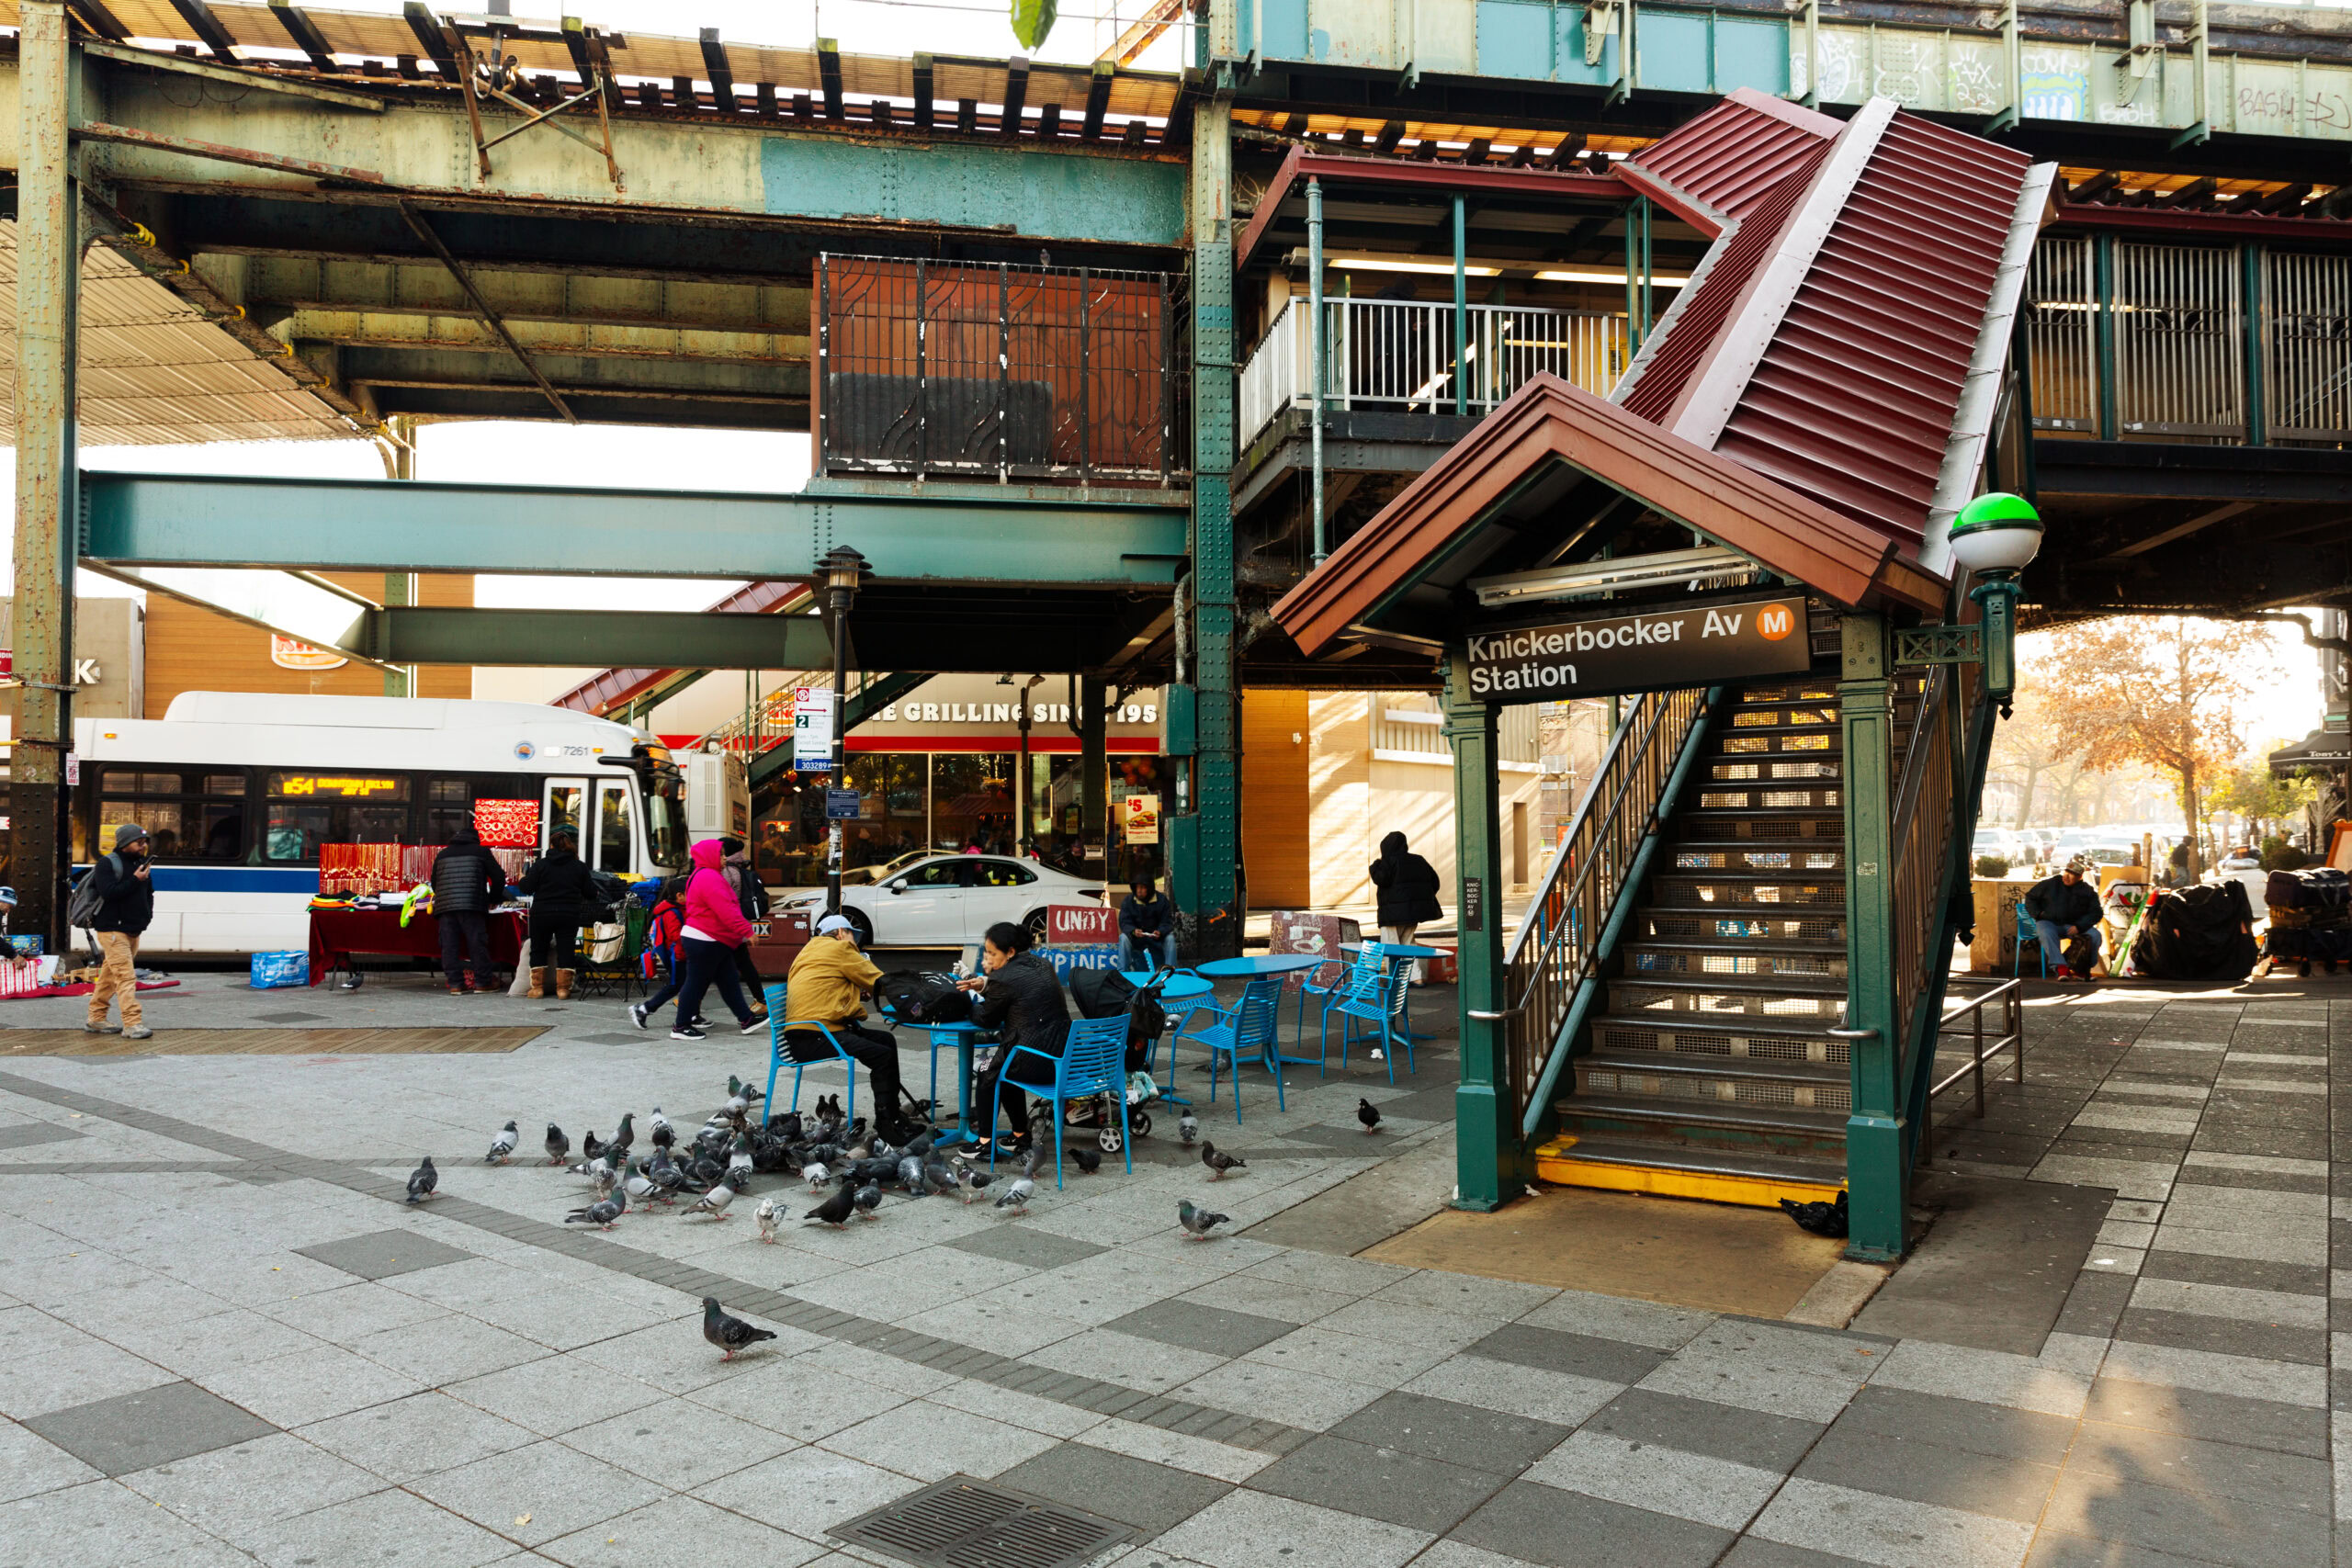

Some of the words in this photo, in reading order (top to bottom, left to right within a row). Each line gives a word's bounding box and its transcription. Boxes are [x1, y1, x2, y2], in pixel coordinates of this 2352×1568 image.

[1468, 618, 1684, 662] Knickerbocker
[1702, 610, 1743, 638] Av
[1763, 611, 1788, 634] M
[1470, 662, 1577, 694] Station
[798, 716, 806, 728] 2
[903, 702, 1023, 723] GRILLING
[1116, 704, 1160, 724] 195
[564, 746, 589, 756] 7261
[801, 761, 827, 770] 303289
[1127, 798, 1143, 813] $5
[1048, 952, 1118, 974] PINES
